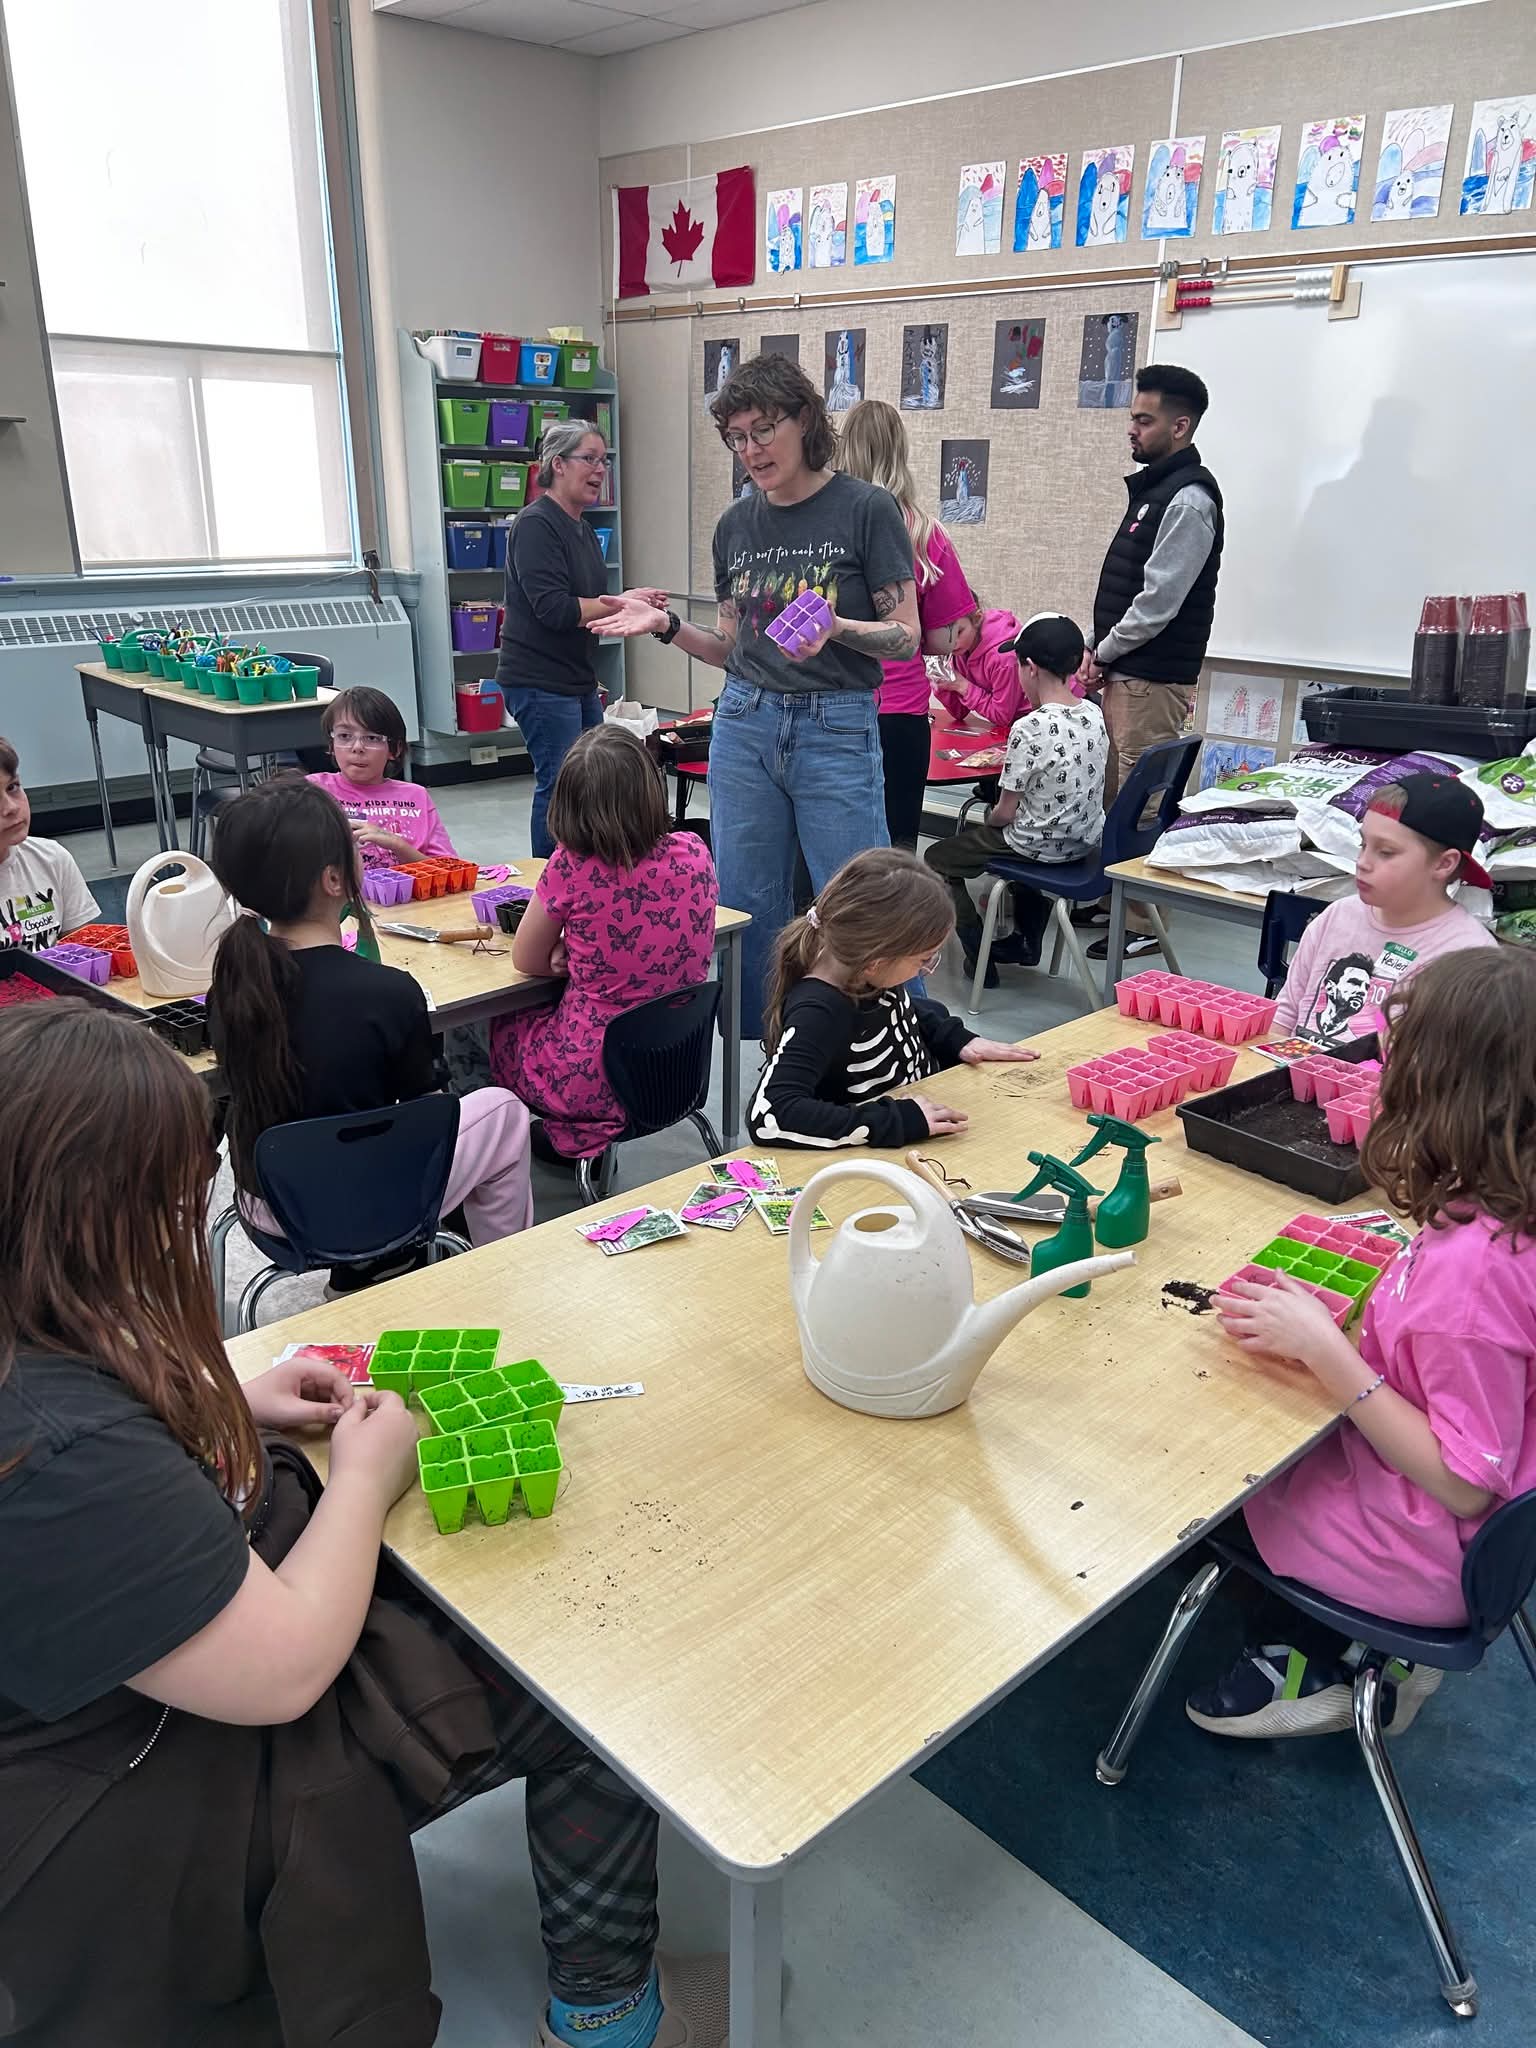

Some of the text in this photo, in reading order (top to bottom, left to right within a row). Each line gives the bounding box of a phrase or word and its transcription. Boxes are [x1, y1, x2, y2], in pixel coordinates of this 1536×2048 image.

[730, 541, 845, 570] Let's root for each other
[365, 799, 389, 808] KIDS'
[393, 799, 416, 808] FUND
[362, 807, 396, 817] SHIRT
[400, 808, 421, 817] DAY
[26, 904, 46, 915] HELLO
[24, 914, 54, 932] Capable
[1394, 944, 1413, 956] HELLO
[1370, 984, 1387, 1005] 10
